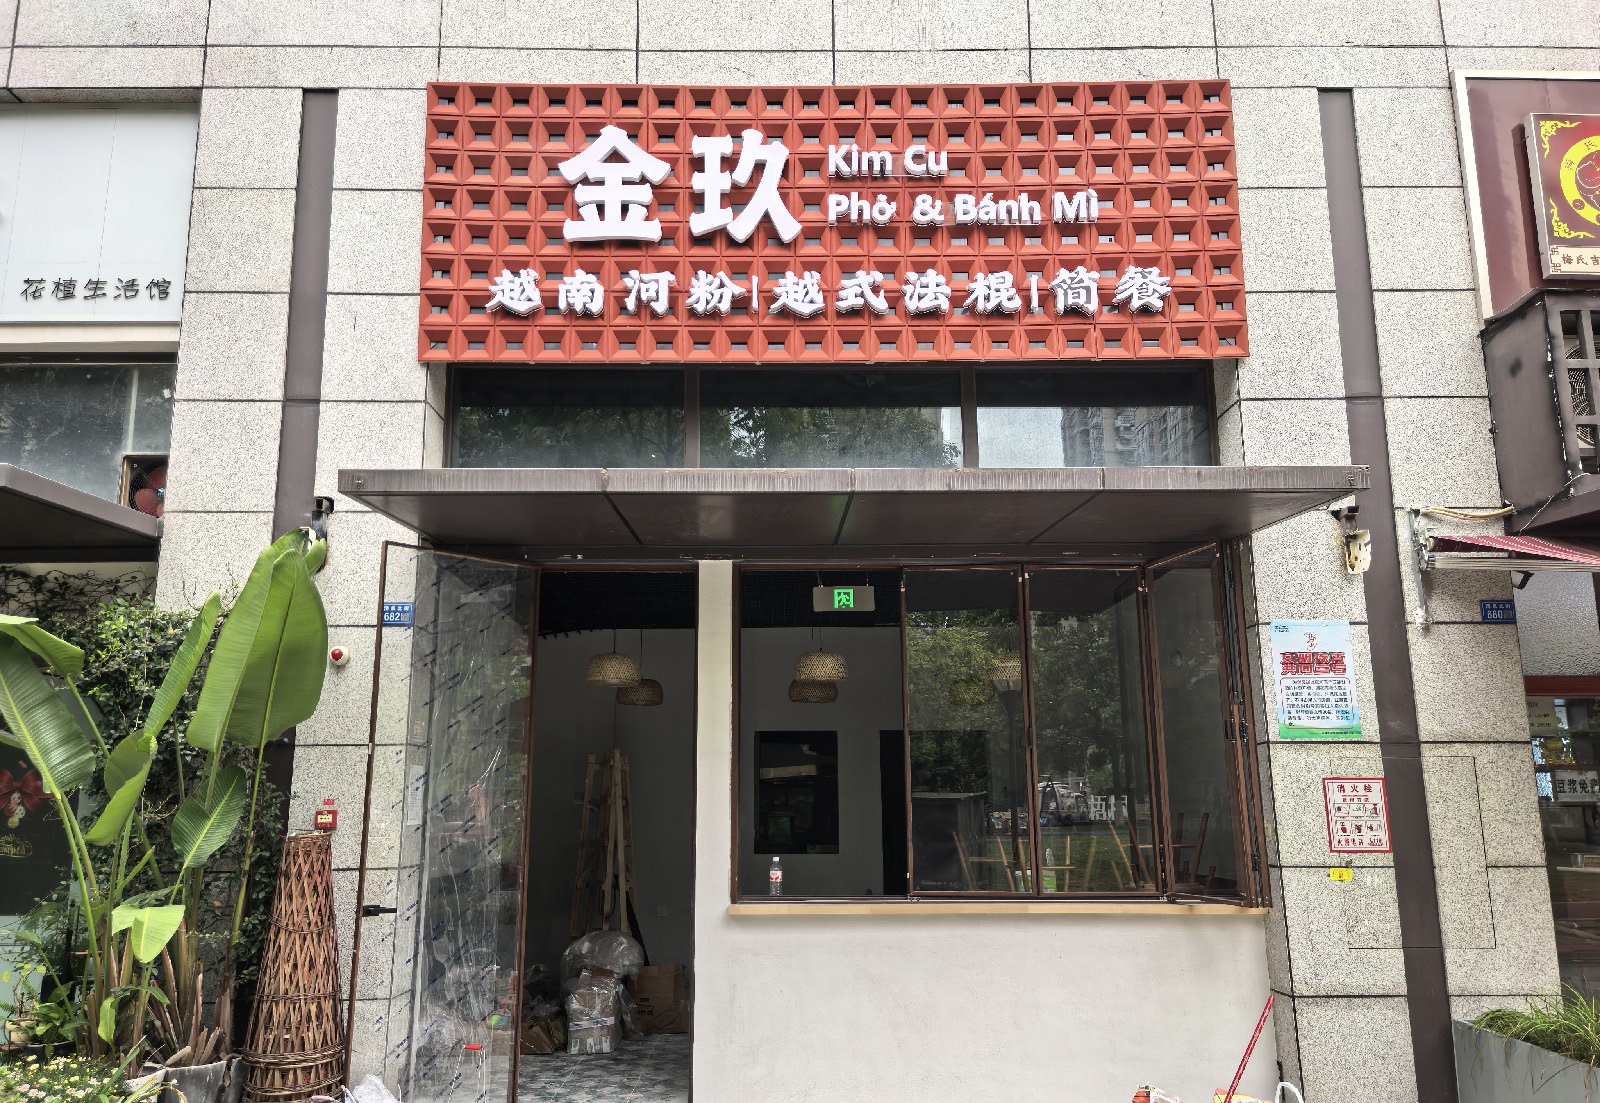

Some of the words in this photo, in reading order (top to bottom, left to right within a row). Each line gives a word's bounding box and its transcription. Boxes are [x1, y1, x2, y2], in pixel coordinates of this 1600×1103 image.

[828, 144, 892, 177] Kim
[903, 144, 948, 177] Cu
[558, 125, 802, 243] 金玖
[912, 194, 945, 226] &
[954, 192, 1041, 225] Bánh
[1053, 188, 1099, 224] Mì
[20, 277, 172, 301] 花植生活馆
[383, 612, 401, 621] 682
[1337, 784, 1373, 793] 消火栓
